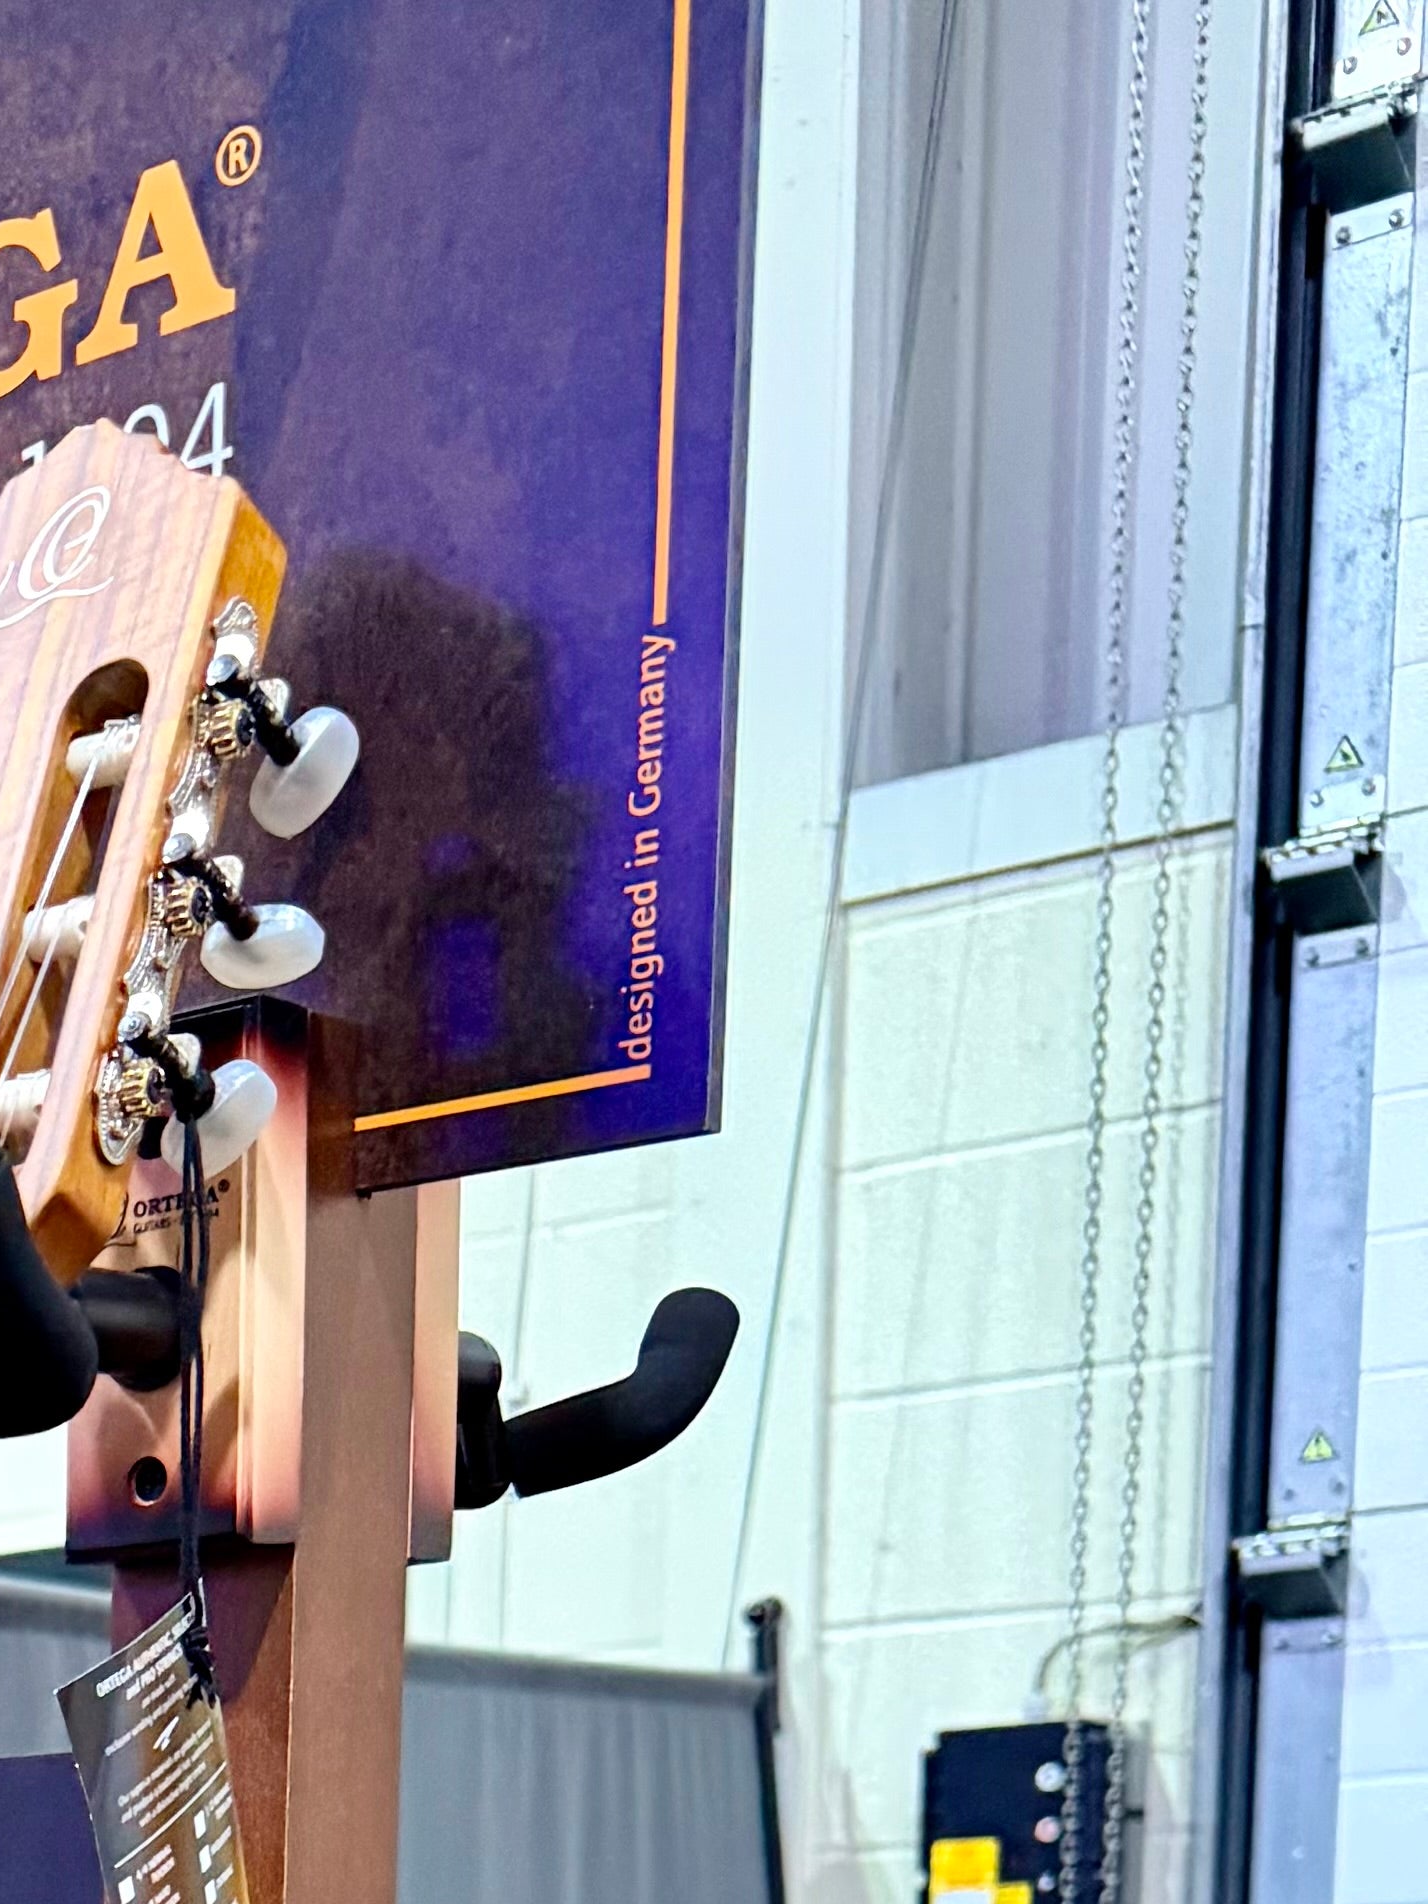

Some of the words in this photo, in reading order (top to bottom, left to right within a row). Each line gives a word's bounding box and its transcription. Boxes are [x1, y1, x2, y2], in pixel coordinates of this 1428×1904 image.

[628, 634, 675, 817] Germany
[624, 828, 659, 870] in
[618, 880, 663, 1060] designed
